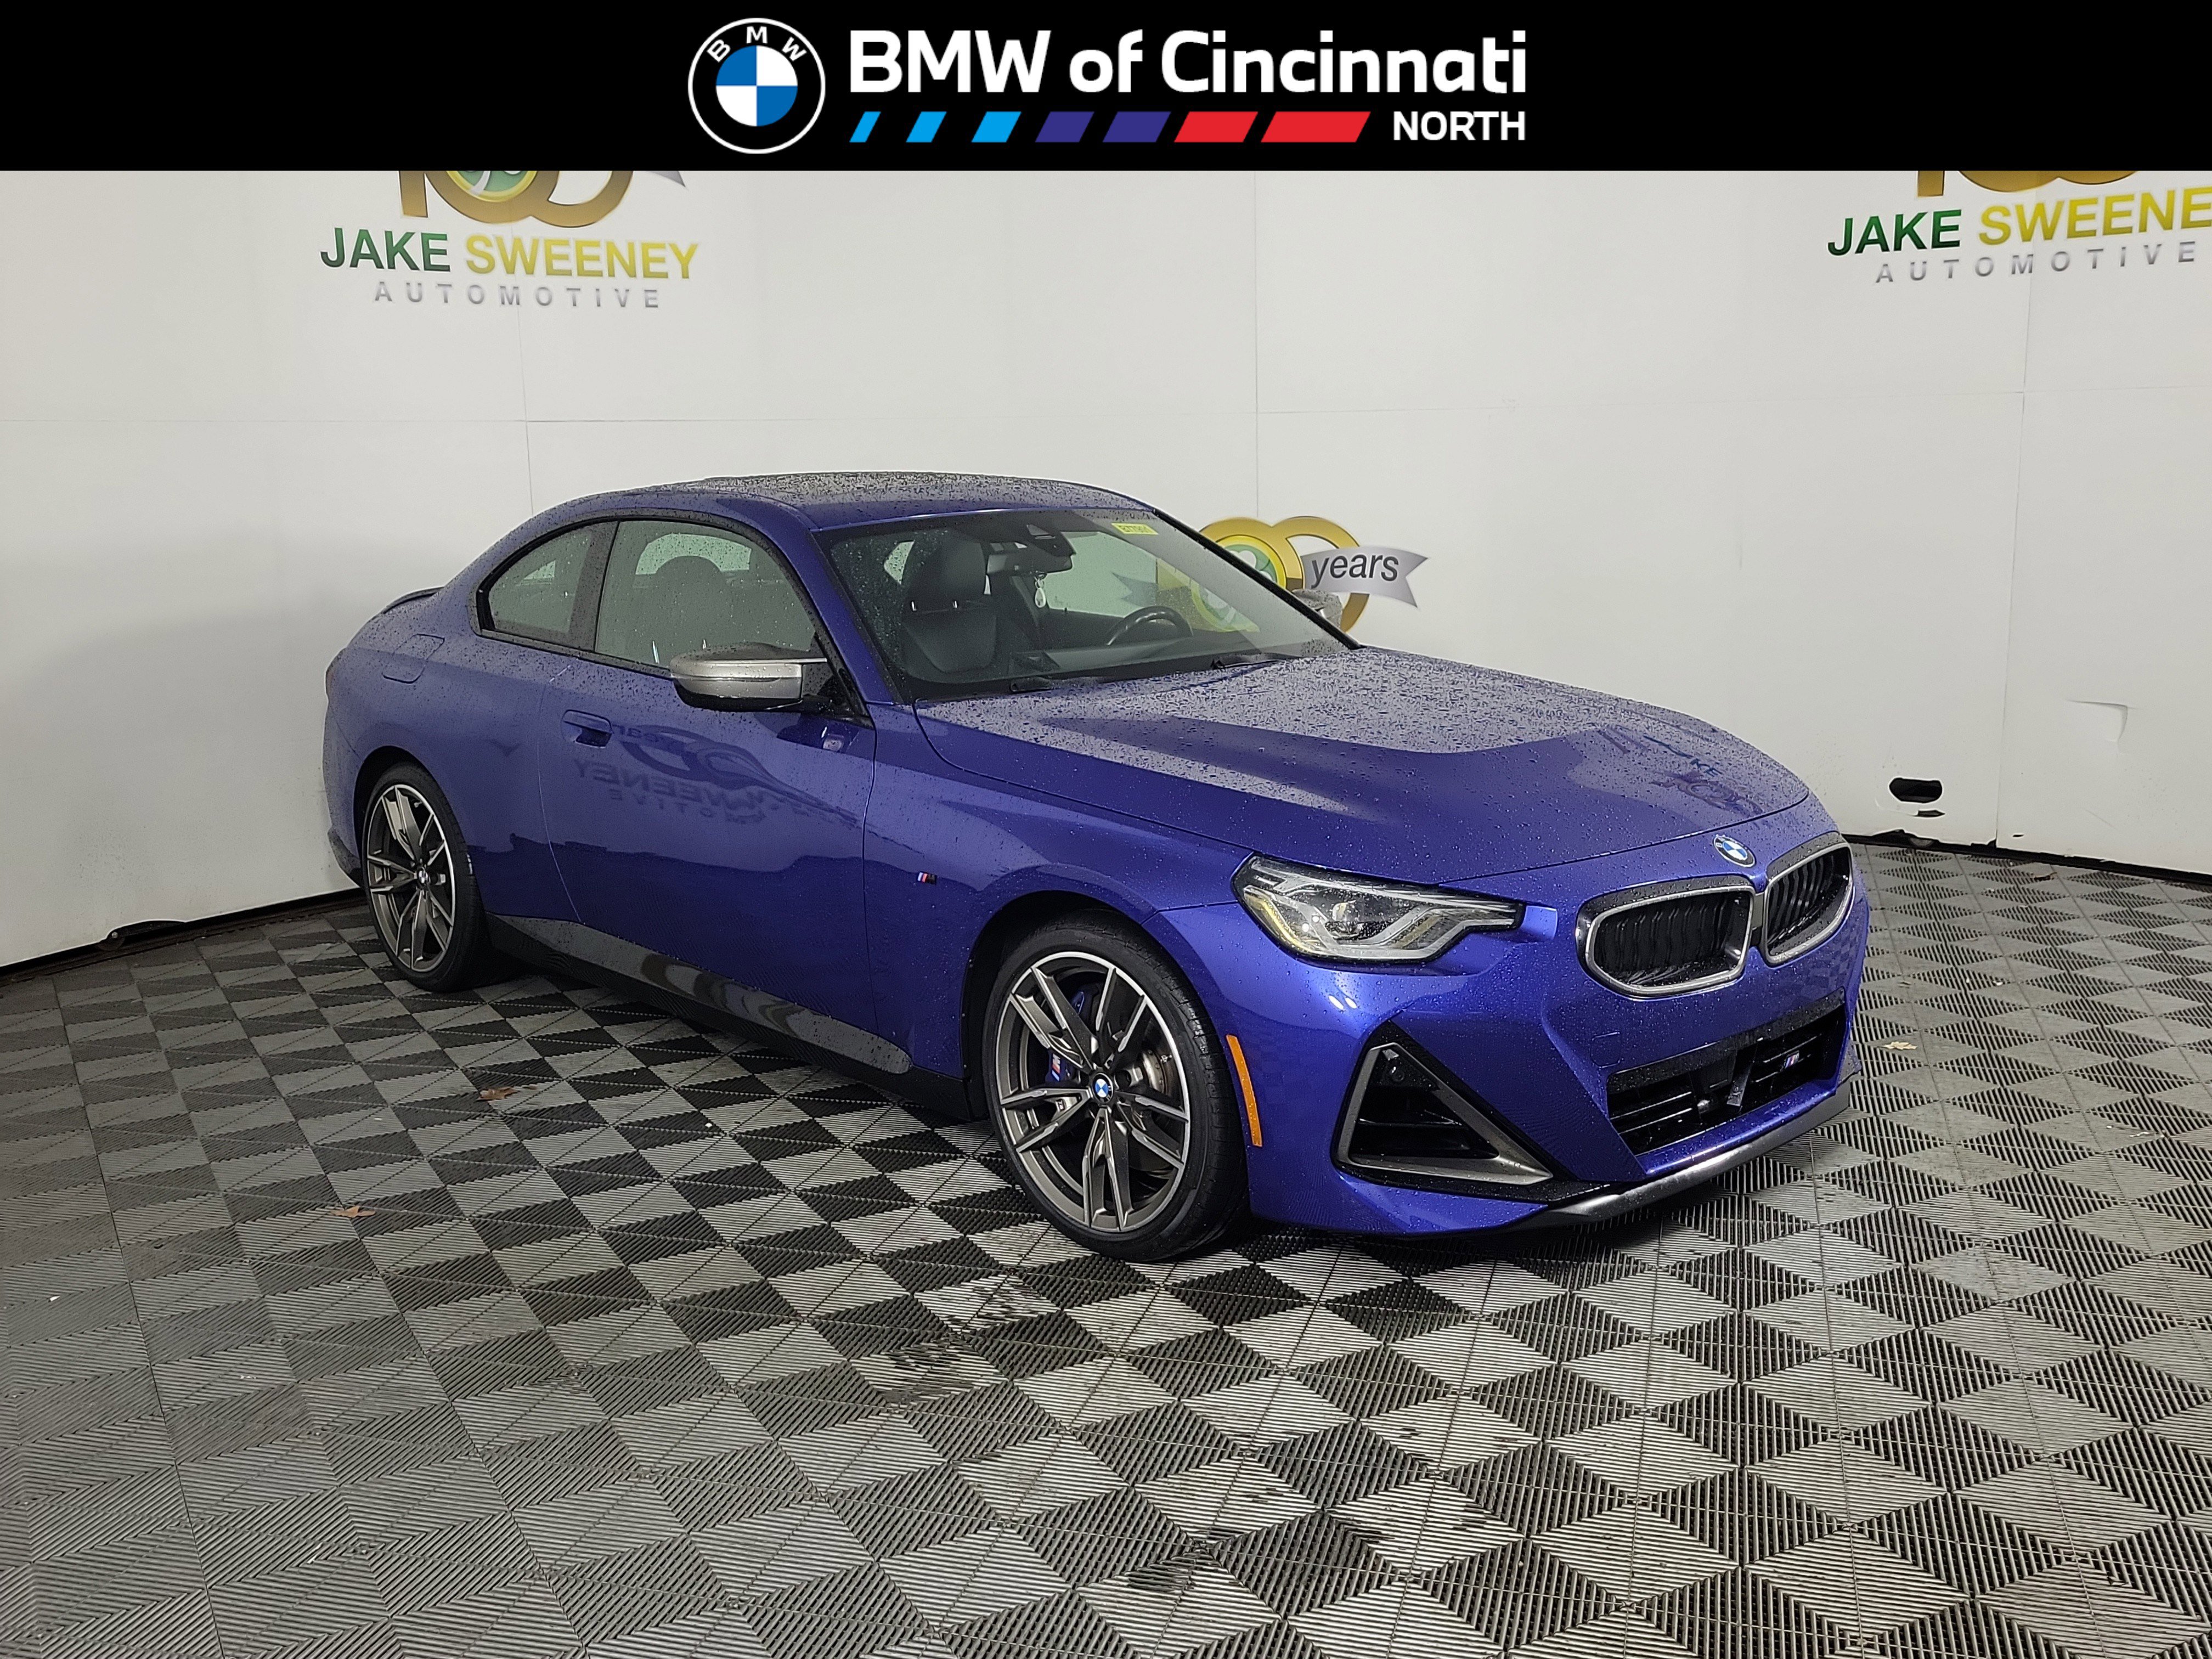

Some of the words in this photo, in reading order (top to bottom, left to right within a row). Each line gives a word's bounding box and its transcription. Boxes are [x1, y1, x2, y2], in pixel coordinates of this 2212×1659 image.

[321, 227, 451, 272] JAKE
[465, 234, 698, 279] SWEENEY
[1827, 210, 1962, 256] JAKE
[1876, 241, 2195, 283] AUTOMOTIVE
[375, 281, 658, 308] AUTOMOTIVE
[1311, 554, 1399, 589] years
